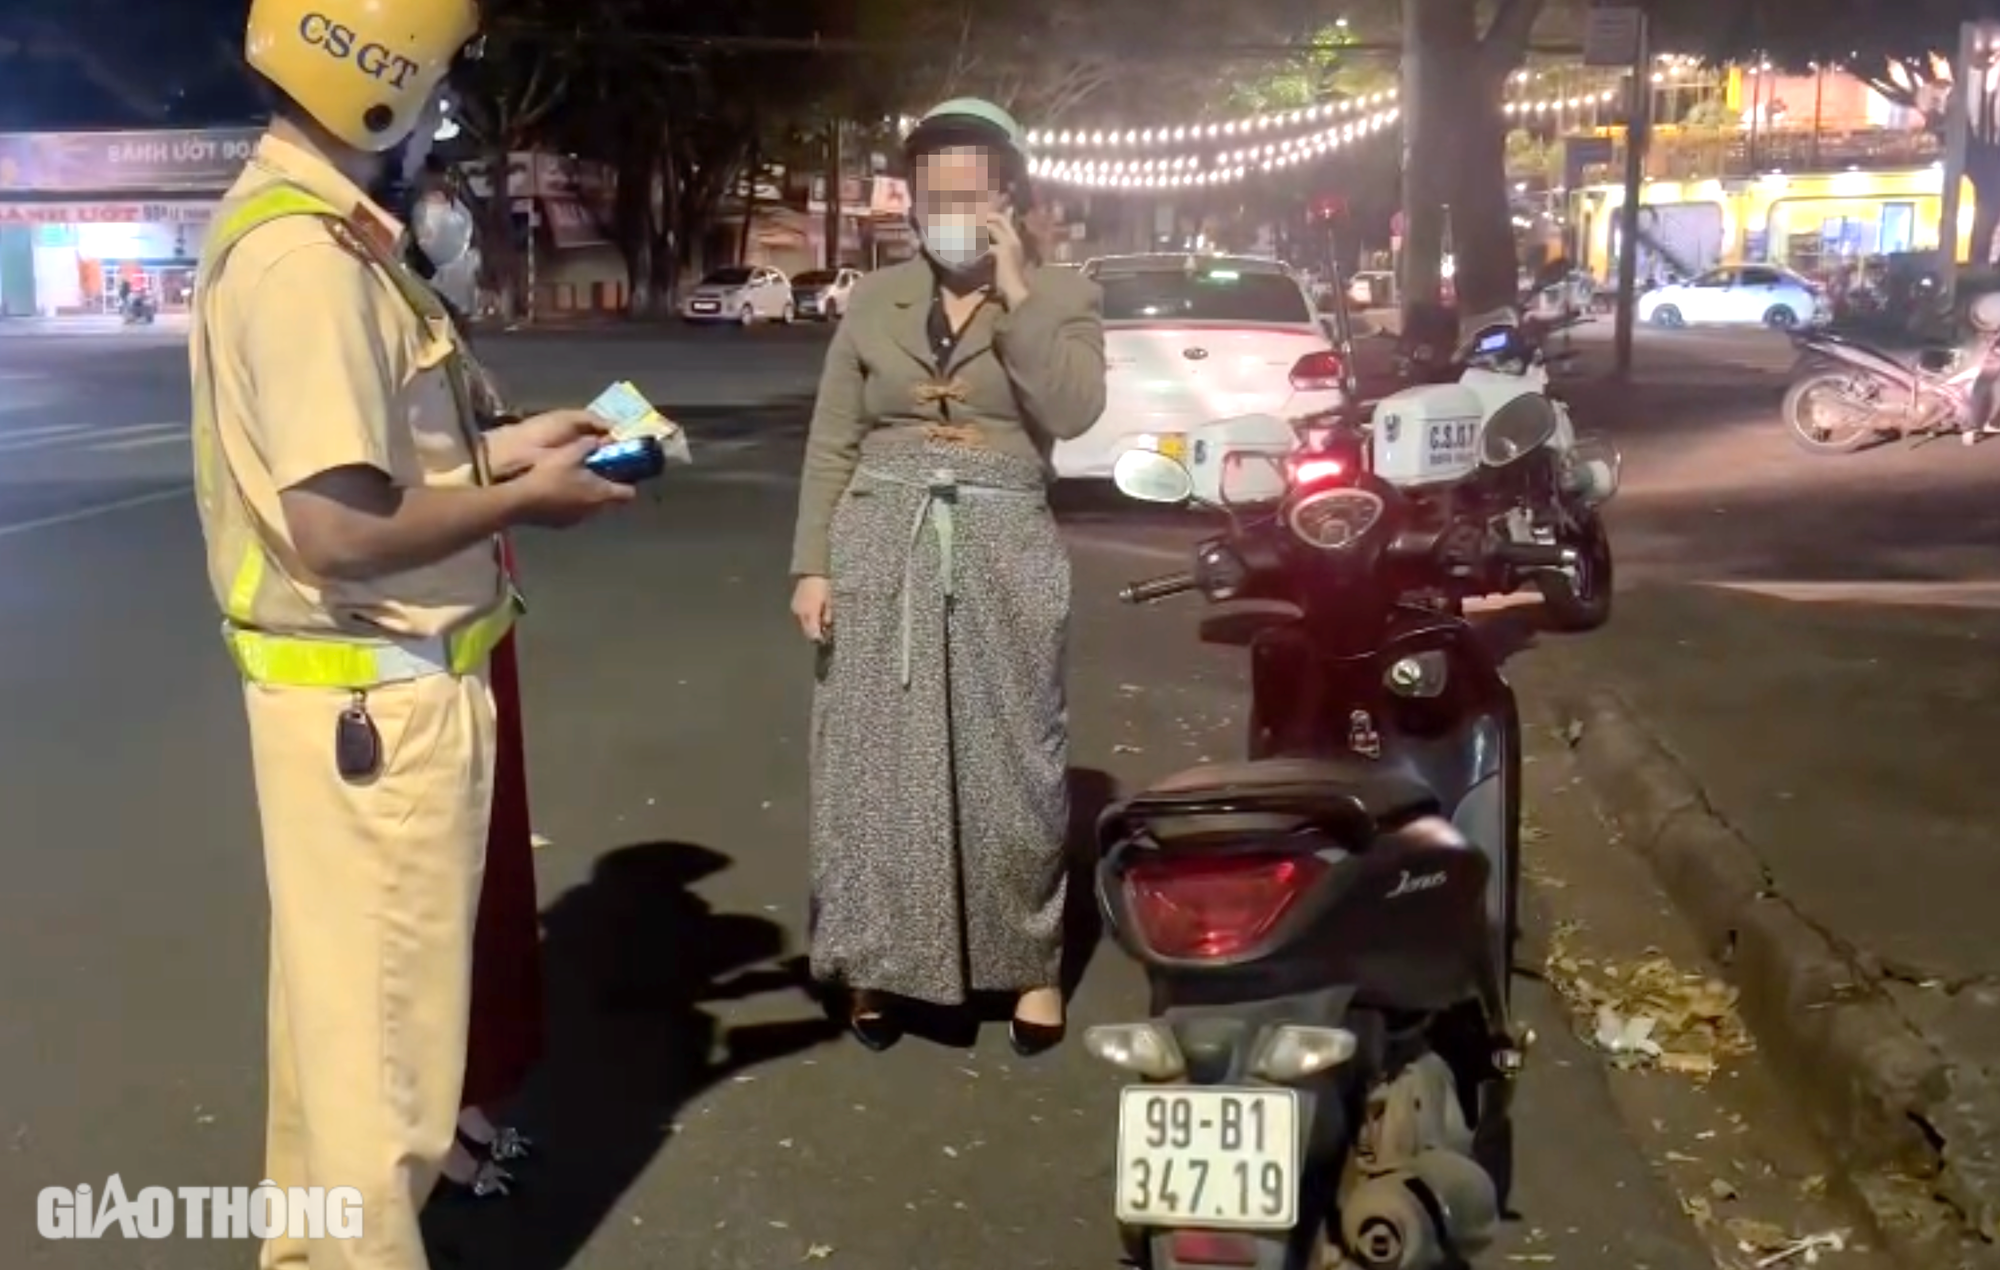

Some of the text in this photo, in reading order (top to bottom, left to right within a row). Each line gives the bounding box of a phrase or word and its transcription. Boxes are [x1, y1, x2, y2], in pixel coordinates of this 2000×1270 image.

[299, 12, 419, 90] CSGT
[1146, 1096, 1265, 1152] 99-B1
[1130, 1157, 1284, 1216] 347.19
